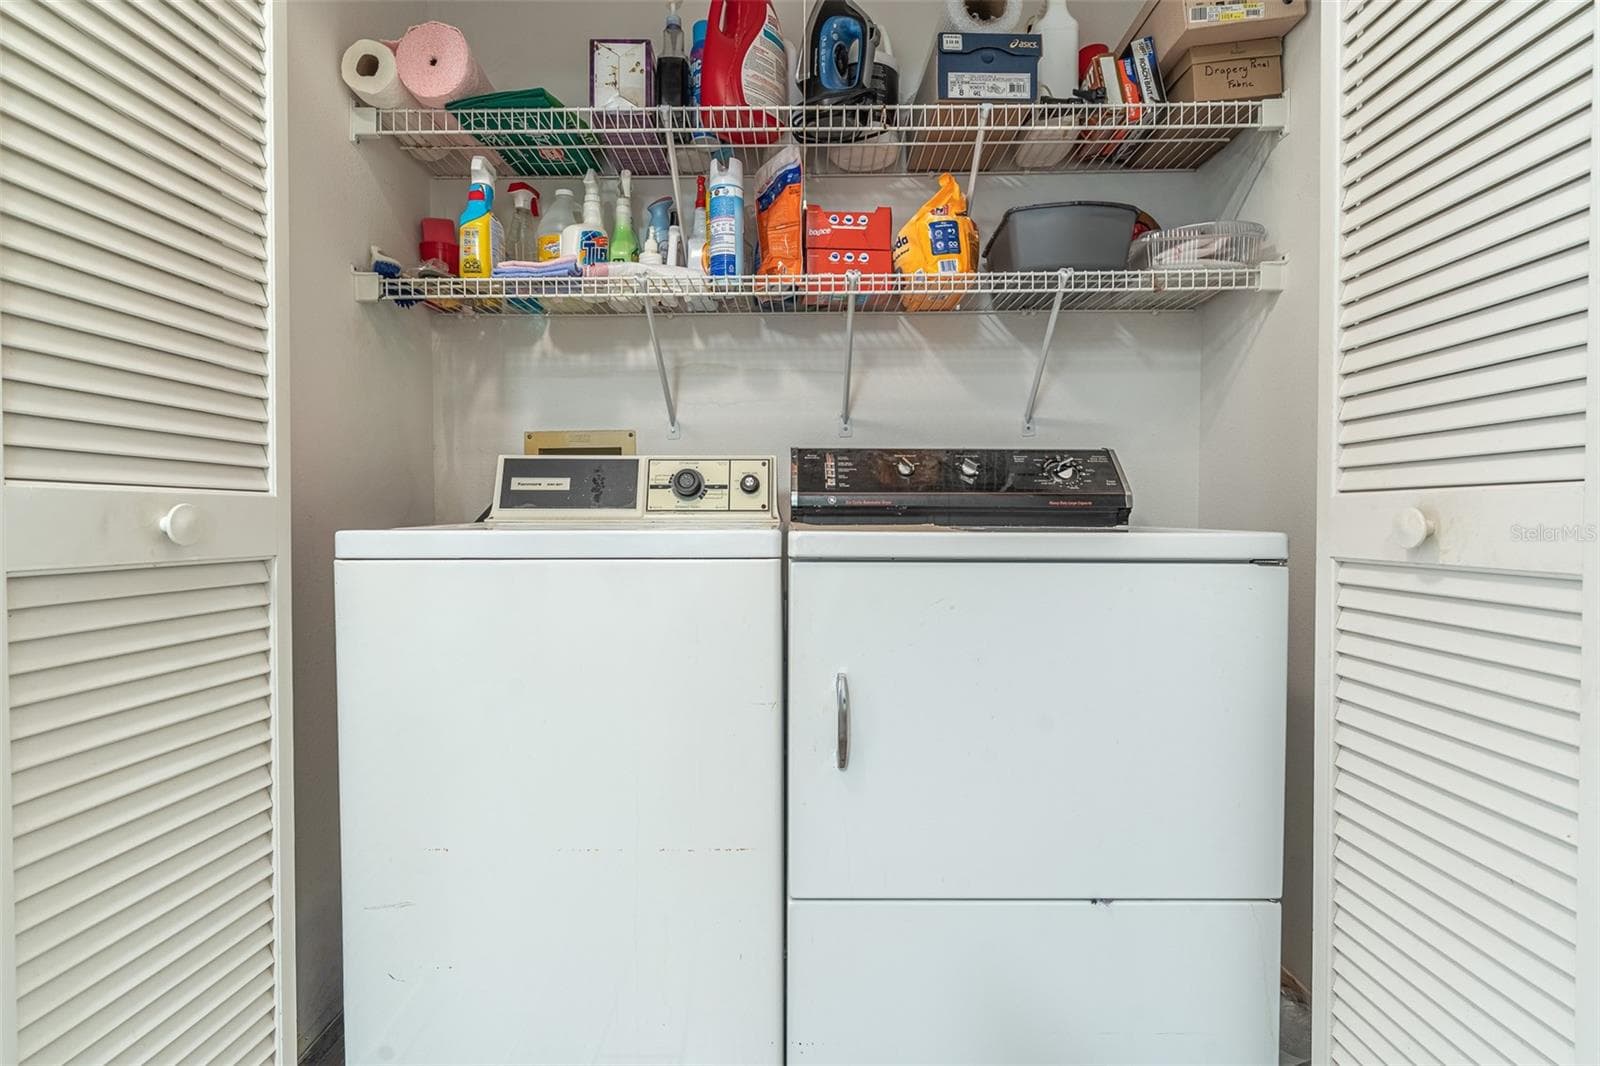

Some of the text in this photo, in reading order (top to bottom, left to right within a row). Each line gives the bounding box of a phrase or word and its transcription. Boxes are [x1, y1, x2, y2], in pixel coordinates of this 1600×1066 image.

[1139, 57, 1153, 96] ROACH BAIT
[1204, 65, 1248, 79] Drapery
[1227, 79, 1255, 89] Fabric
